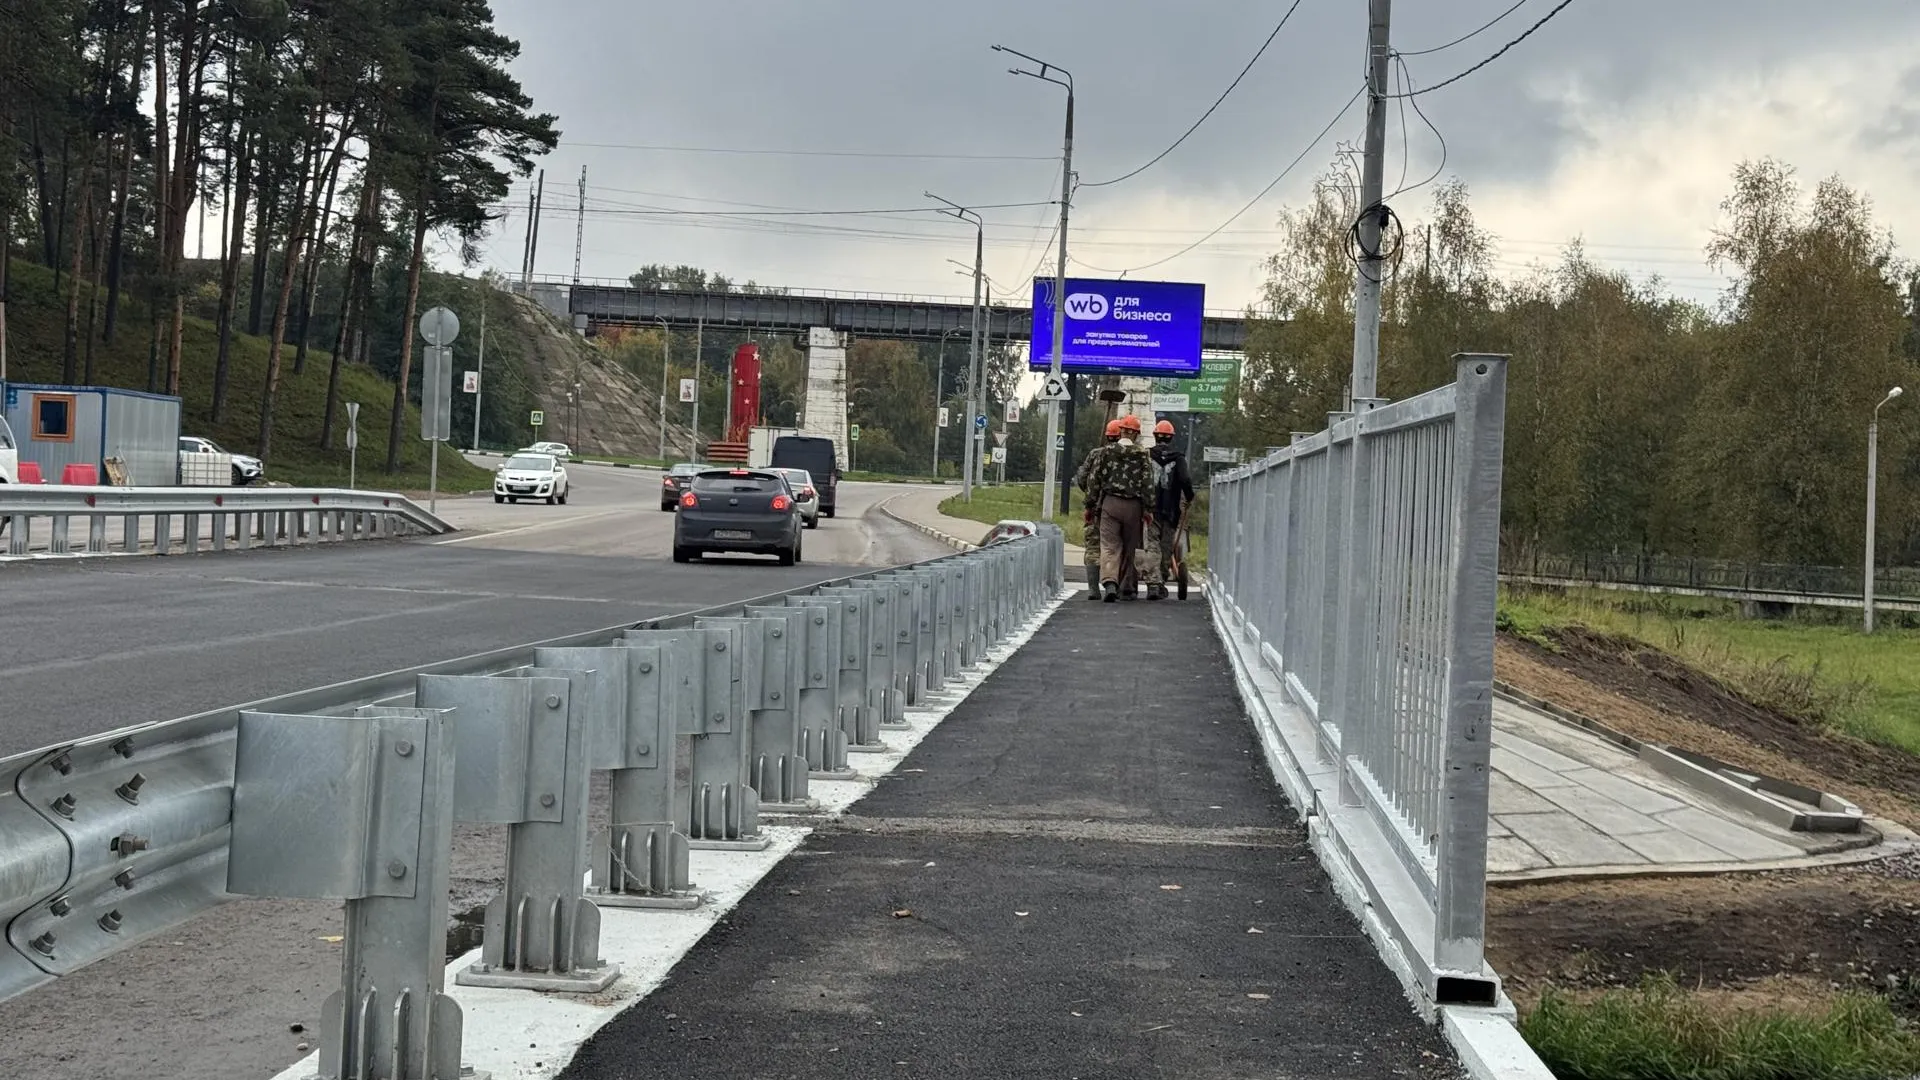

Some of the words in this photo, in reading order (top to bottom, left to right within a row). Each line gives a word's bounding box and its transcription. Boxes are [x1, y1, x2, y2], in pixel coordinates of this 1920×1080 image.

[1069, 295, 1103, 314] wb
[1114, 296, 1140, 307] для
[1113, 307, 1172, 322] бизнеса
[1205, 363, 1233, 371] КЛЕВЕР
